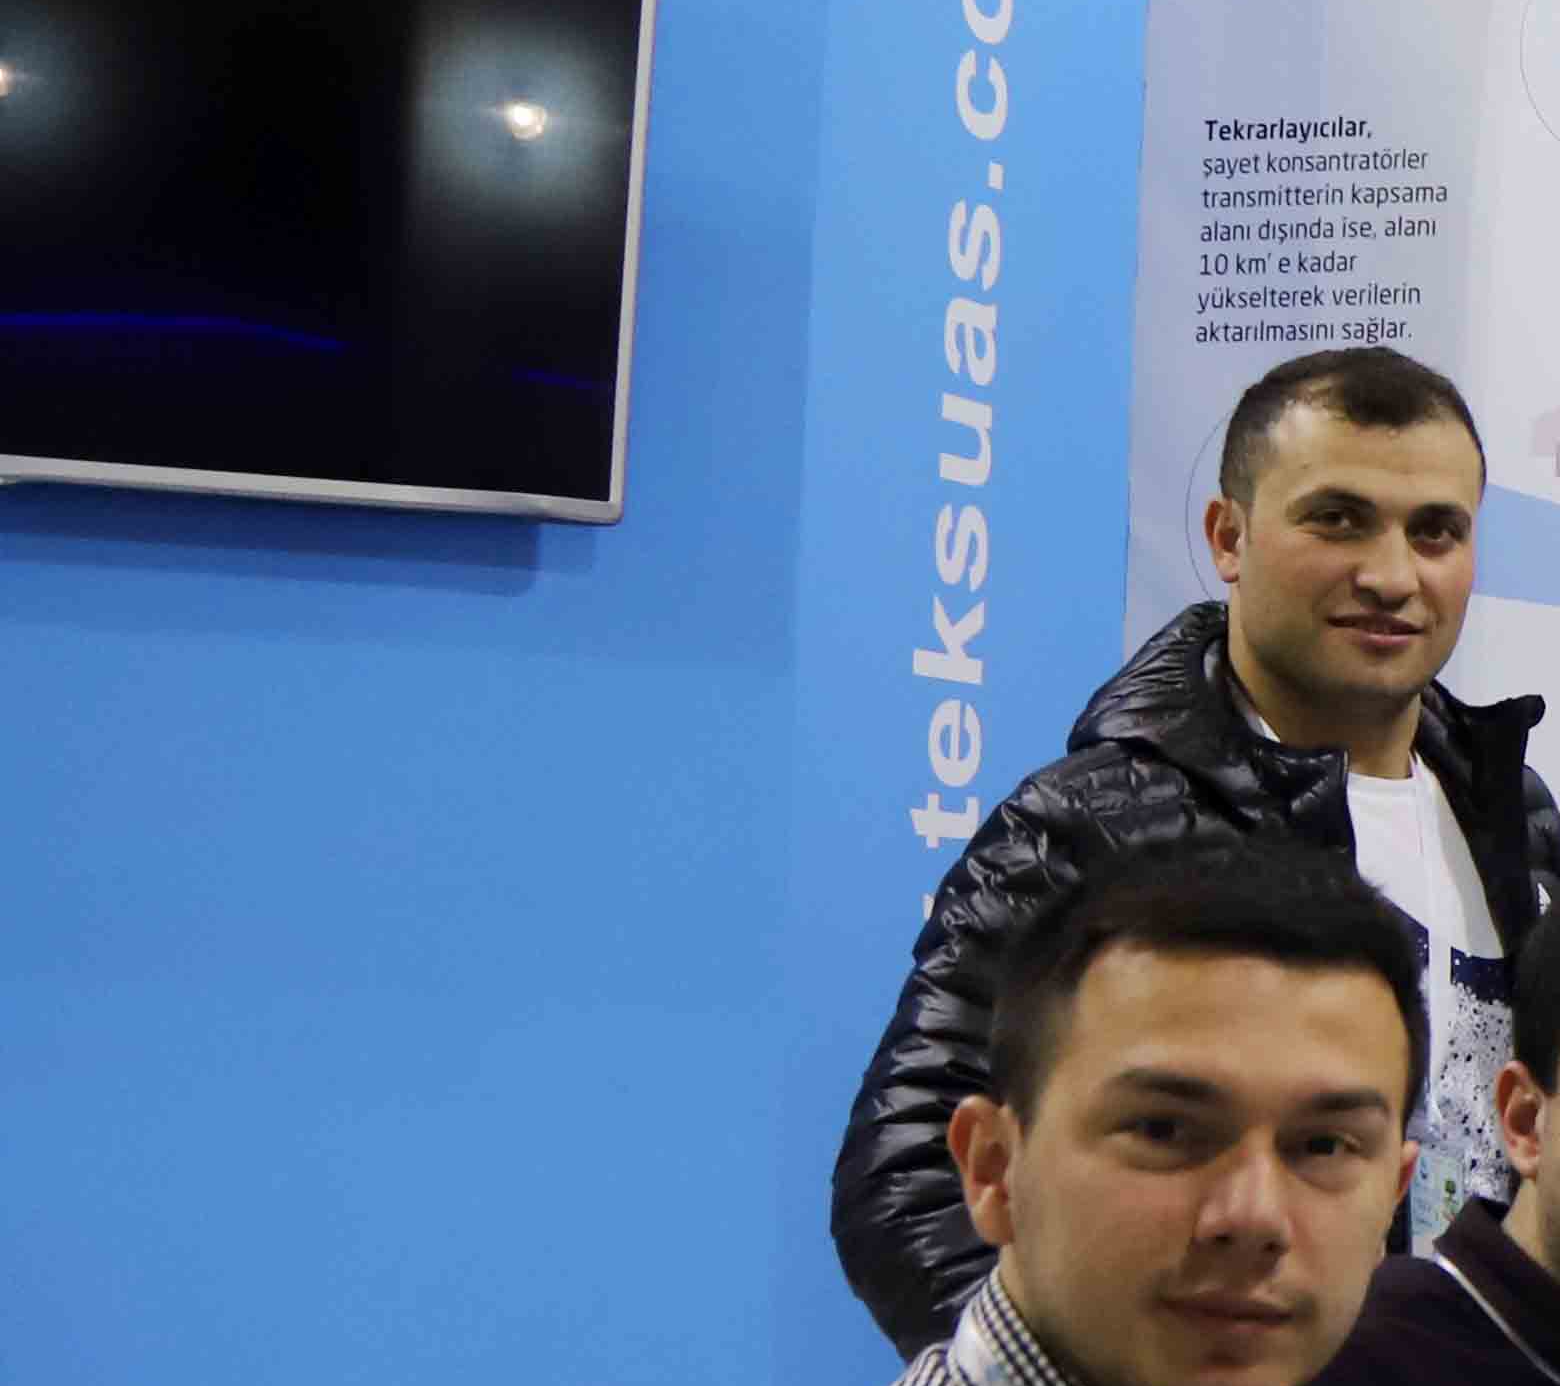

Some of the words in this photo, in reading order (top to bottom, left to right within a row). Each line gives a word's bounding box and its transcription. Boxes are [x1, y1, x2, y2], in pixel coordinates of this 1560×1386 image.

[1204, 115, 1372, 144] Tekrarlayıcılar,
[1202, 153, 1261, 181] şayet
[1266, 148, 1429, 174] konsantratörler
[1201, 182, 1344, 210] transmitterin
[1351, 182, 1448, 210] kapsama
[1199, 220, 1251, 243] alanı
[1257, 216, 1335, 246] dışında
[1384, 215, 1437, 238] alanı
[1199, 252, 1229, 277] 10
[1277, 256, 1291, 274] e
[1297, 249, 1358, 274] kadar
[1196, 284, 1325, 315] yükselterek
[1331, 282, 1421, 307] verilerin
[1195, 319, 1335, 344] aktarılmasını
[1341, 316, 1412, 347] sağlar.
